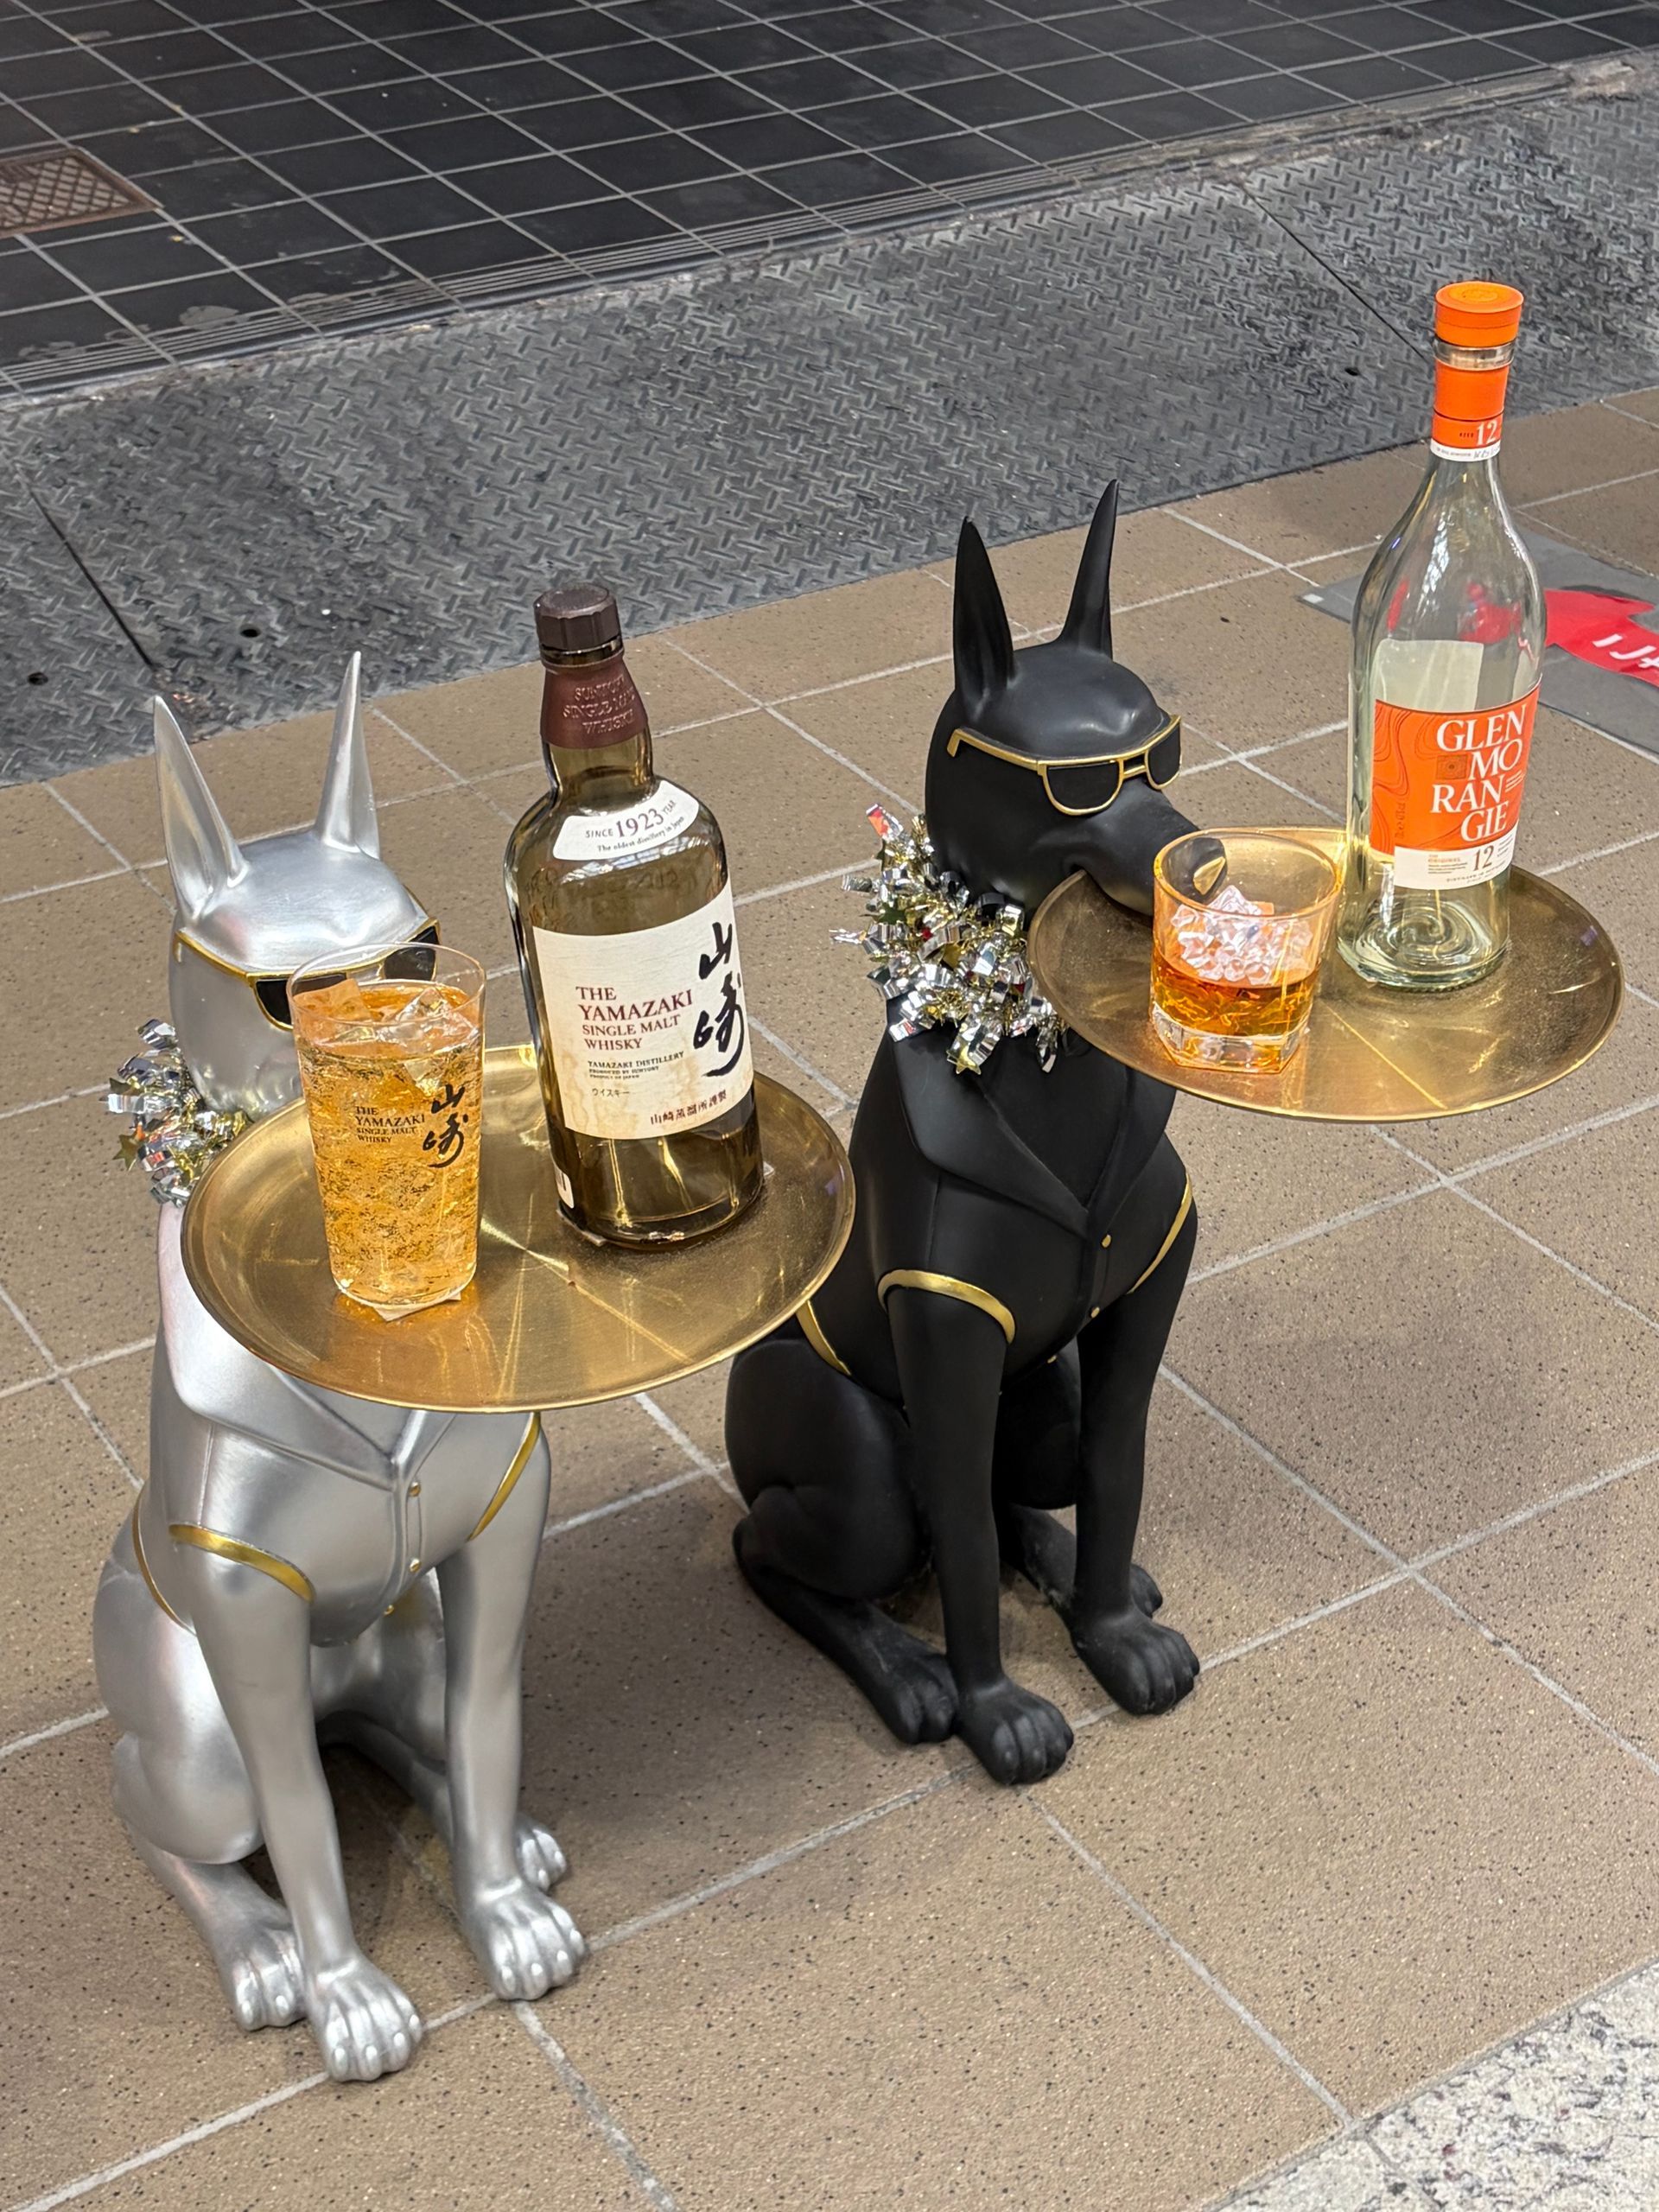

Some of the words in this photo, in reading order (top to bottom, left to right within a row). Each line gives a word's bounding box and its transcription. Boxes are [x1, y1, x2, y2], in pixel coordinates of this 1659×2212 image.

[1476, 419, 1498, 447] 12
[1436, 703, 1527, 752] GLEN
[1467, 739, 1523, 782] MO
[1430, 774, 1504, 814] RAN
[584, 829, 613, 839] SINCE
[615, 807, 664, 838] 1923
[1460, 800, 1509, 842] GIE
[613, 840, 636, 850] oldest
[1473, 844, 1495, 872] 12
[575, 986, 616, 1001] THE
[578, 989, 693, 1021] YAMAZAKI
[582, 1023, 636, 1037] SINGLE
[640, 1014, 681, 1032] MALT
[584, 1038, 643, 1051] WHISKY
[588, 1060, 633, 1069] YAMAZAKI
[635, 1051, 684, 1067] DISTILLERY
[591, 1088, 630, 1097] ウイスキー
[355, 1105, 379, 1116] THE
[354, 1114, 425, 1128] YAMAZAKI
[356, 1127, 389, 1135] SINGLE
[391, 1126, 417, 1135] MALT
[357, 1135, 392, 1143] WHISKY
